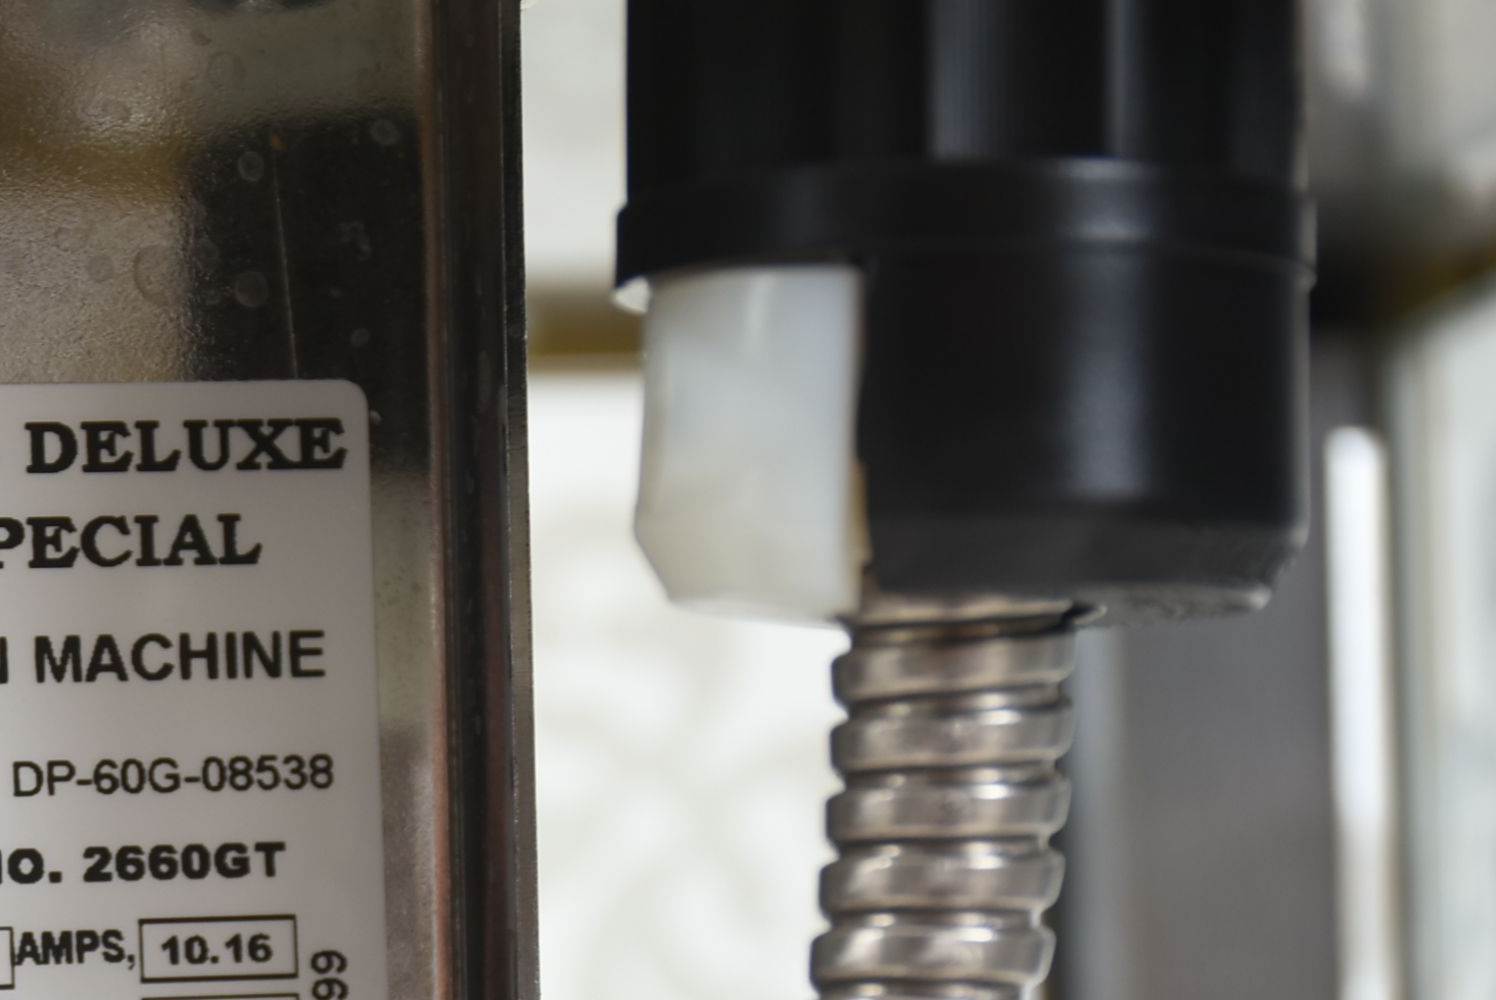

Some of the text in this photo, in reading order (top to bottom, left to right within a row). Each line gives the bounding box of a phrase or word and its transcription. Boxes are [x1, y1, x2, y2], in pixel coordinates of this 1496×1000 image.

[24, 417, 348, 474] DELUXE
[33, 629, 326, 684] MACHINE
[12, 753, 335, 798] DP-60G-08538
[82, 841, 288, 884] 2660GT
[14, 929, 137, 972] AMPS,
[160, 932, 275, 966] 10.16
